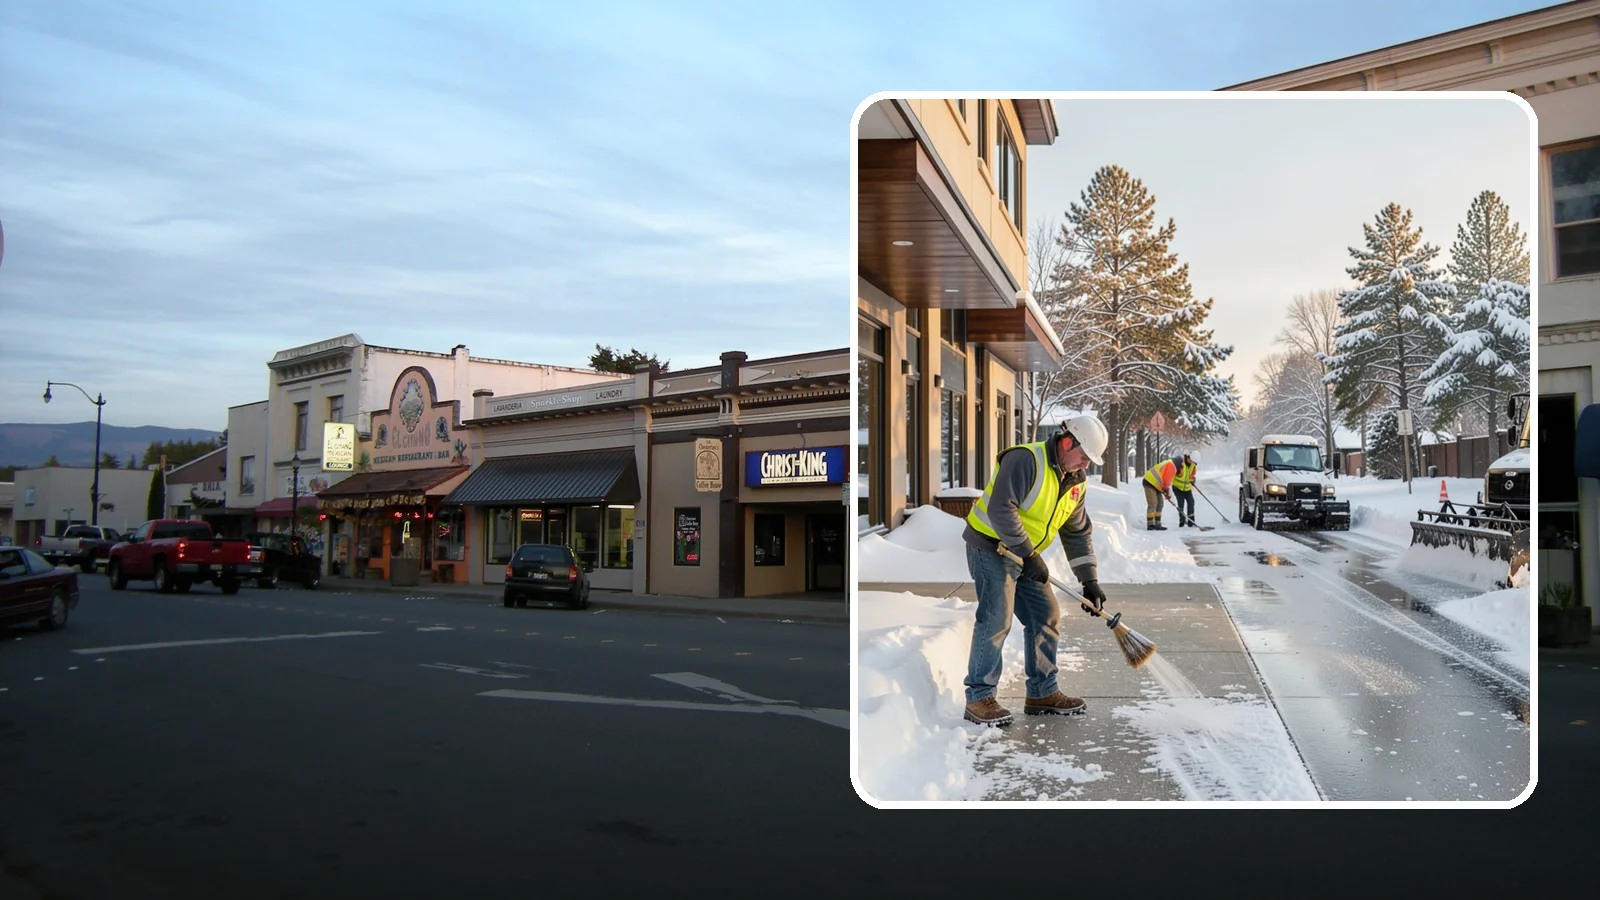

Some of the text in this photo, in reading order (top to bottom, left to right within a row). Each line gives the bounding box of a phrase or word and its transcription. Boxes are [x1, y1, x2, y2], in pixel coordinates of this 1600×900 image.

[561, 393, 582, 405] Shop
[595, 388, 623, 399] LAUNDRY
[493, 402, 522, 412] LAVANDERIA
[397, 451, 433, 462] RESTAURANT
[437, 450, 450, 459] BAR
[760, 450, 827, 478] CHRIST KING
